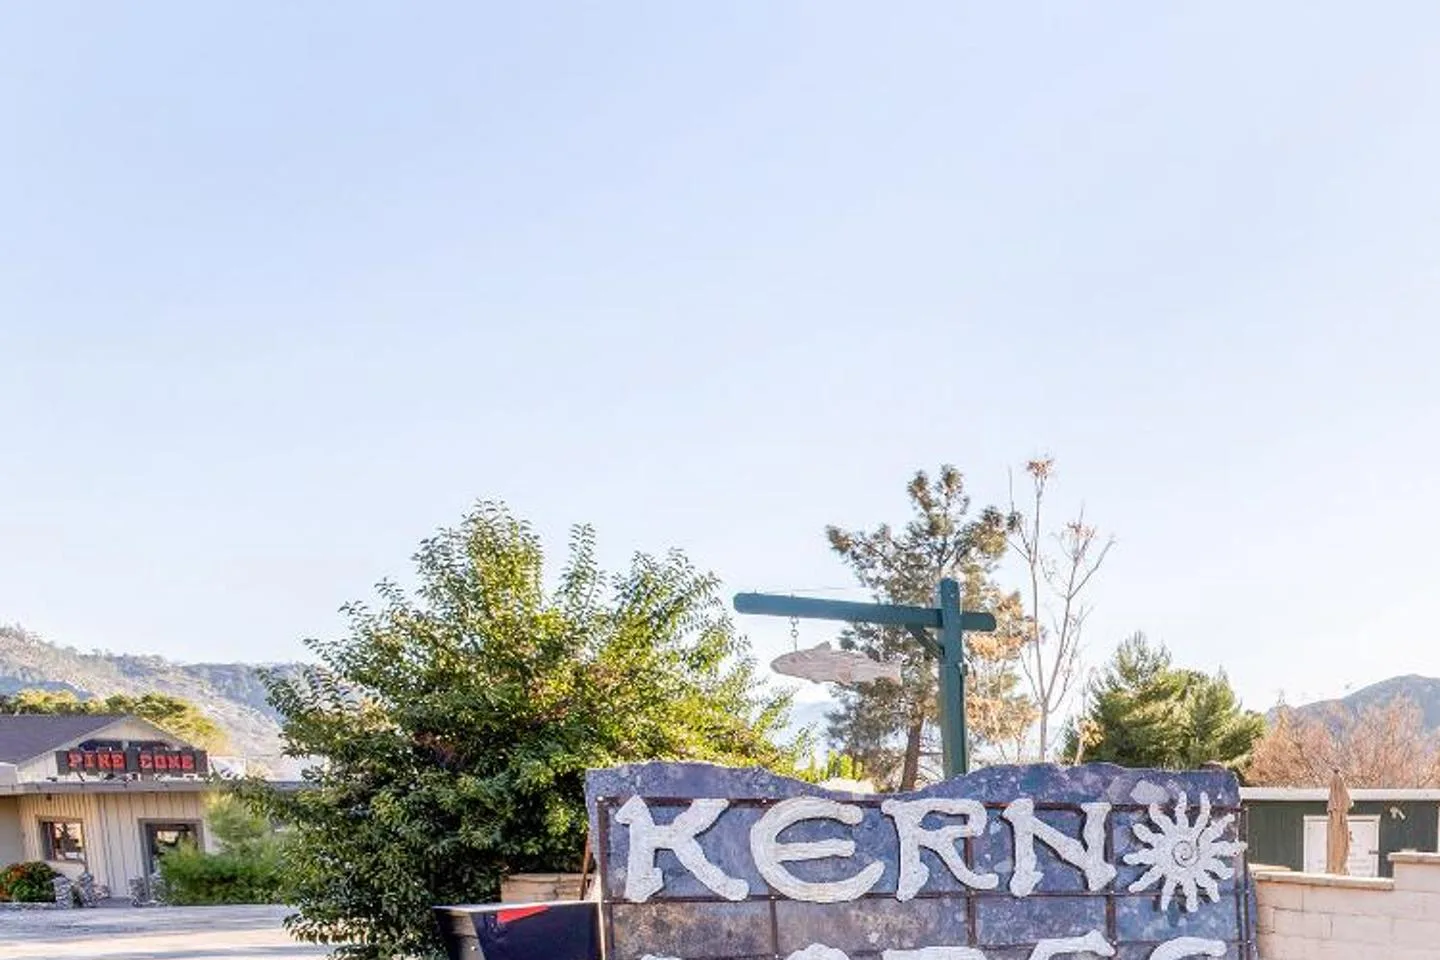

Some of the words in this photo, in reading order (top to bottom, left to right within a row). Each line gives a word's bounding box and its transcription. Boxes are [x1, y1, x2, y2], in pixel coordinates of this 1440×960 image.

[69, 751, 125, 769] PINE
[139, 752, 194, 770] CONE
[614, 795, 1116, 902] KERN
